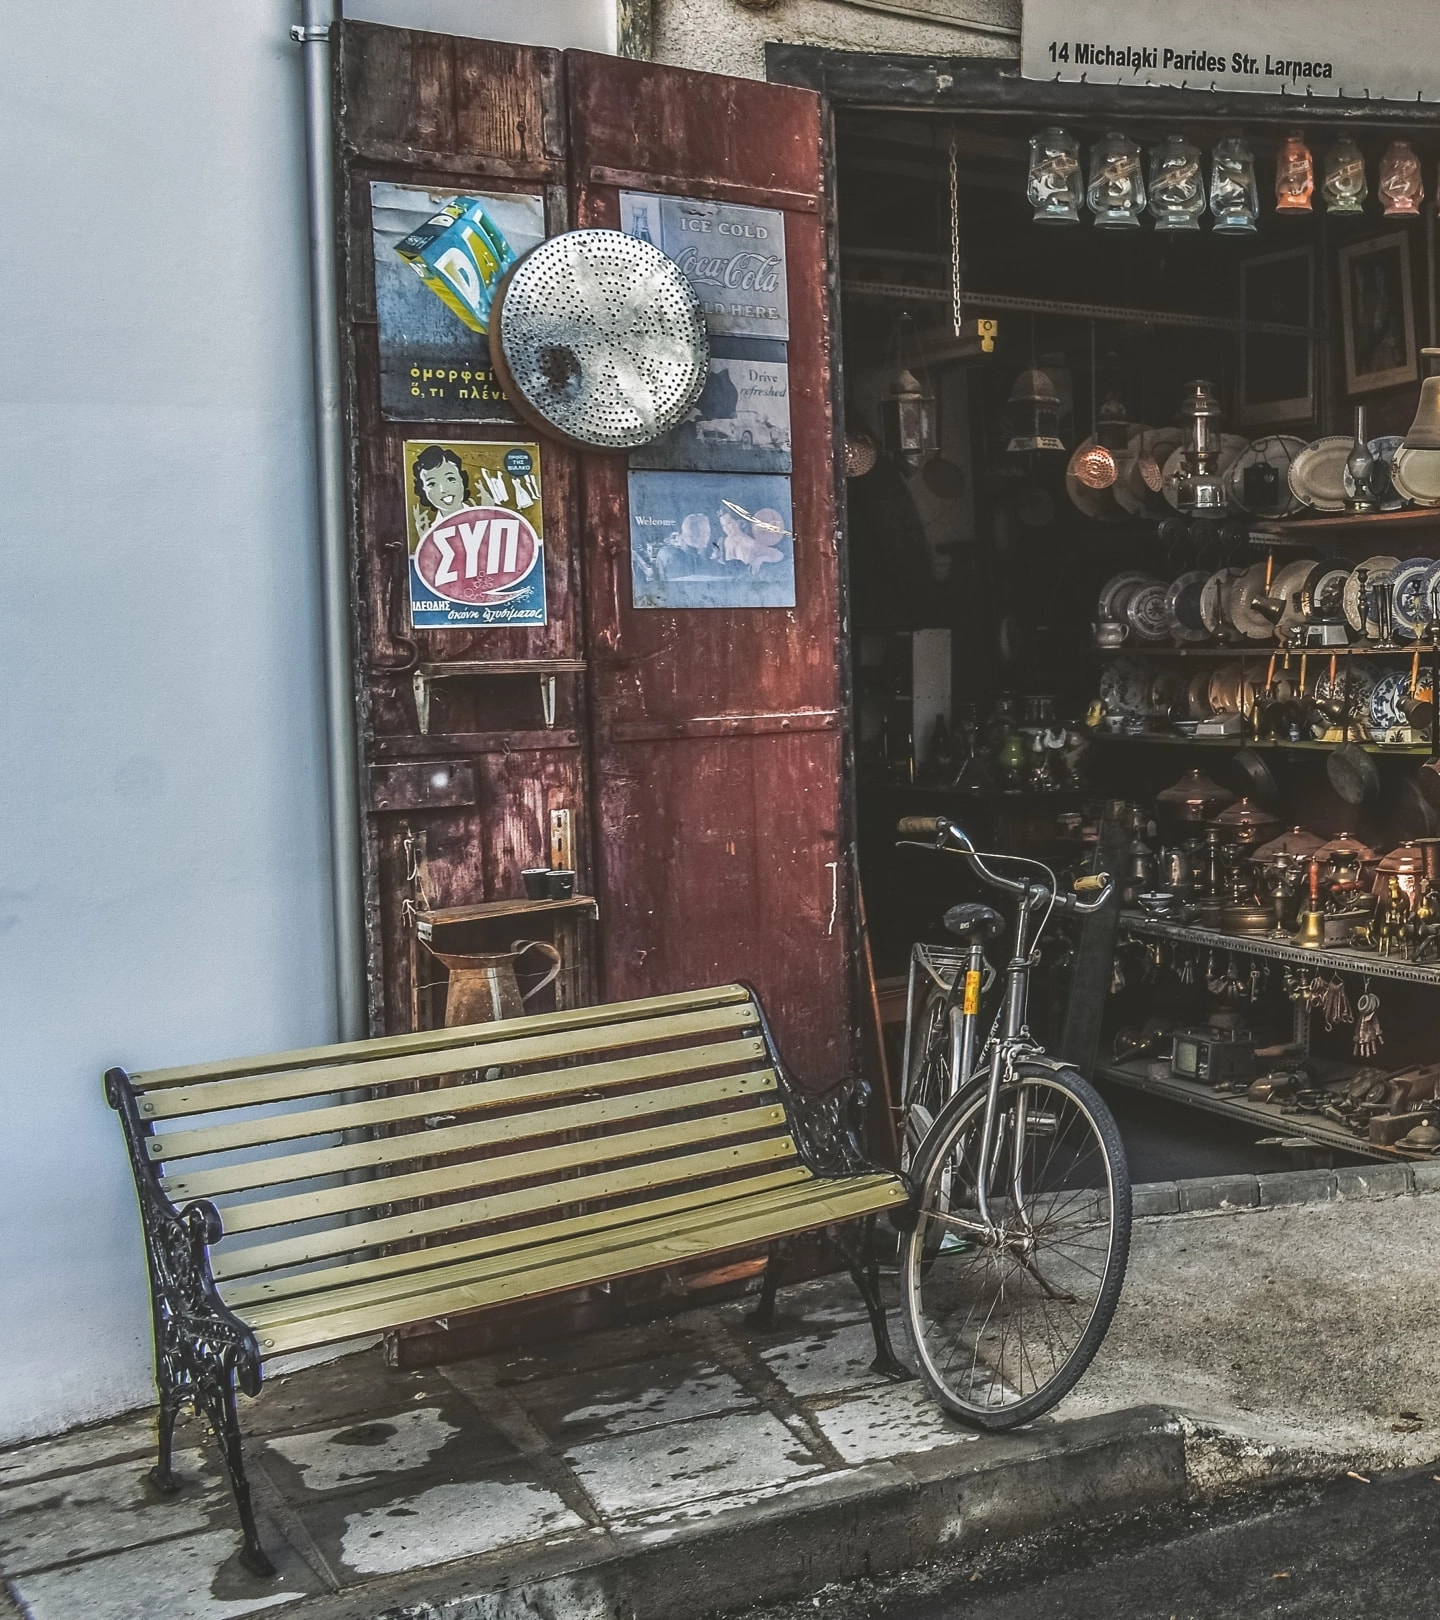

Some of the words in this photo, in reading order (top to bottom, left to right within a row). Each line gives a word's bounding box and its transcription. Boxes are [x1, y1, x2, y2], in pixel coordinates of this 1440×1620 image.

[1049, 42, 1069, 63] 14
[1075, 43, 1157, 69] Michalaki
[1163, 48, 1226, 74] Parides
[1231, 52, 1259, 75] Str.
[1265, 54, 1333, 79] Larnaca
[680, 218, 712, 233] ICE
[718, 223, 769, 239] COLD
[704, 302, 726, 315] LD
[731, 304, 779, 319] HERE
[749, 369, 778, 383] Drive
[741, 384, 787, 399] refreshed
[635, 516, 677, 526] Welcome
[432, 519, 520, 587] ΣΥΠ
